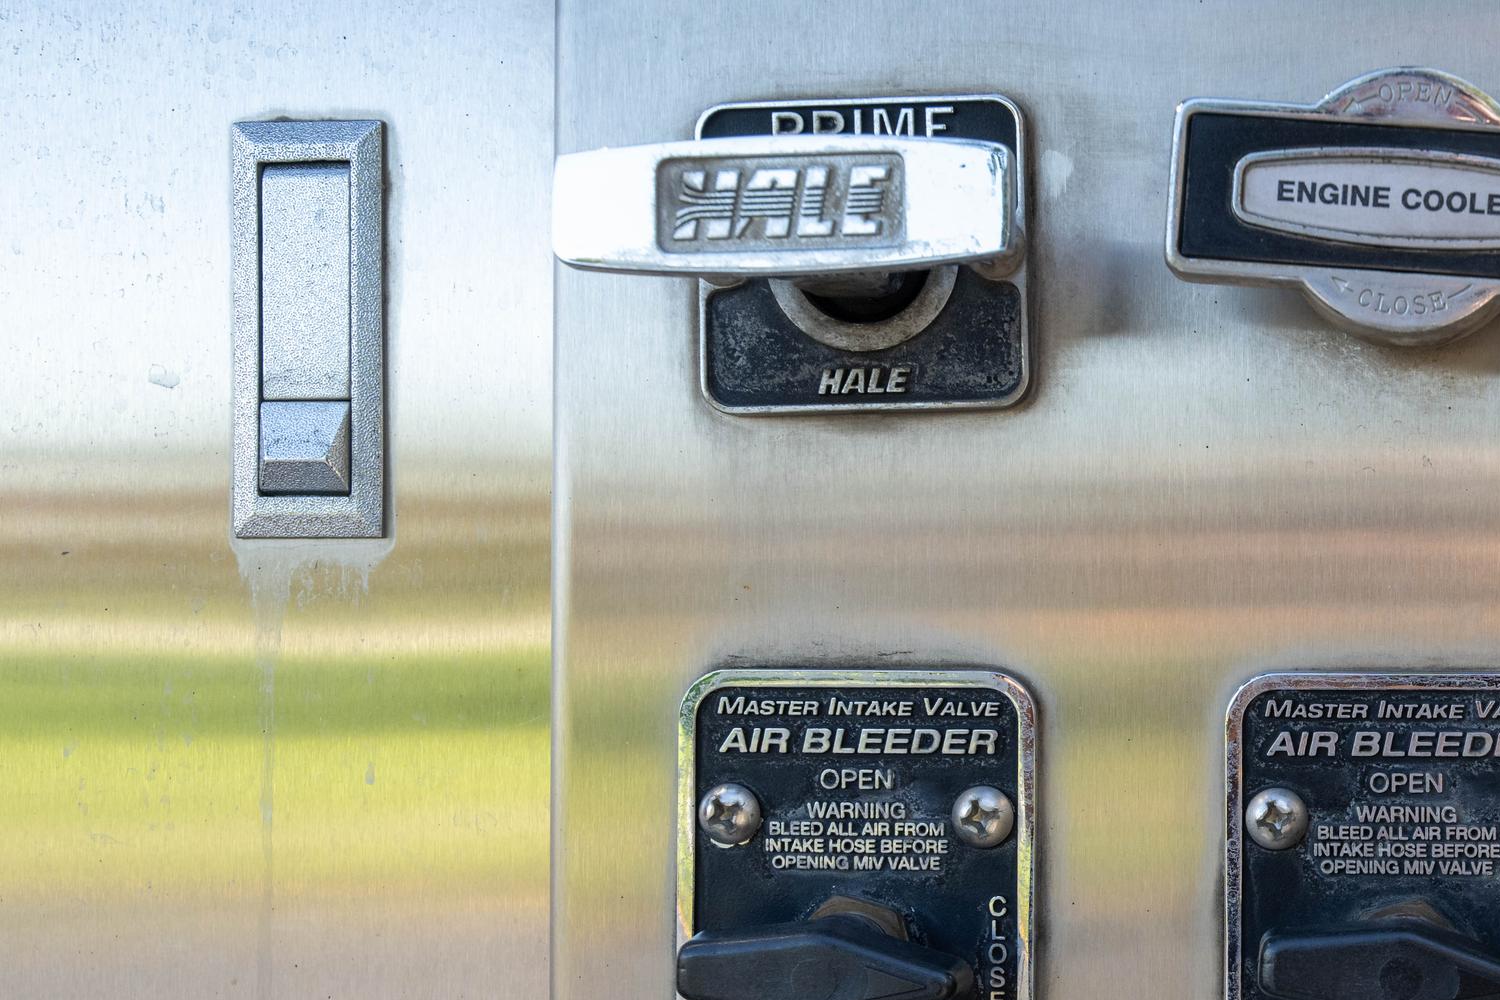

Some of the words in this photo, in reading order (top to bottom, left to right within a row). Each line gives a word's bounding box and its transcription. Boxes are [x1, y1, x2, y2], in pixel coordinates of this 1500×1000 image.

[1377, 81, 1453, 105] OPEN
[673, 164, 892, 242] HALE
[1276, 180, 1391, 208] ENGINE
[1357, 289, 1448, 315] CLOSE
[818, 367, 912, 395] HALE
[719, 728, 790, 753] AIR
[802, 729, 999, 755] BLEEDER
[1266, 732, 1339, 757] AIR
[819, 769, 894, 790] OPEN
[1369, 772, 1444, 794] OPEN
[807, 801, 906, 820] WARNING
[1356, 805, 1457, 824] WARNING
[769, 821, 824, 836] BLEED
[826, 821, 858, 836] ALL
[861, 822, 891, 837] AIR
[895, 822, 944, 837] FROM
[1317, 825, 1373, 840] BLEED
[1376, 826, 1408, 841] ALL
[1412, 826, 1442, 841] AIR
[1446, 826, 1496, 841] FROM
[765, 838, 824, 852] INTAKE
[829, 838, 878, 853] HOSE
[881, 839, 948, 854] BEFORE
[1313, 843, 1374, 858] INTAKE
[1378, 843, 1428, 858] HOSE
[1432, 844, 1500, 859] BEFORE
[772, 855, 849, 870] OPENING
[854, 856, 885, 870] MIV
[887, 856, 941, 871] VALVE
[1320, 860, 1399, 875] OPENING
[1404, 860, 1436, 875] MIV
[1439, 861, 1493, 876] VALVE
